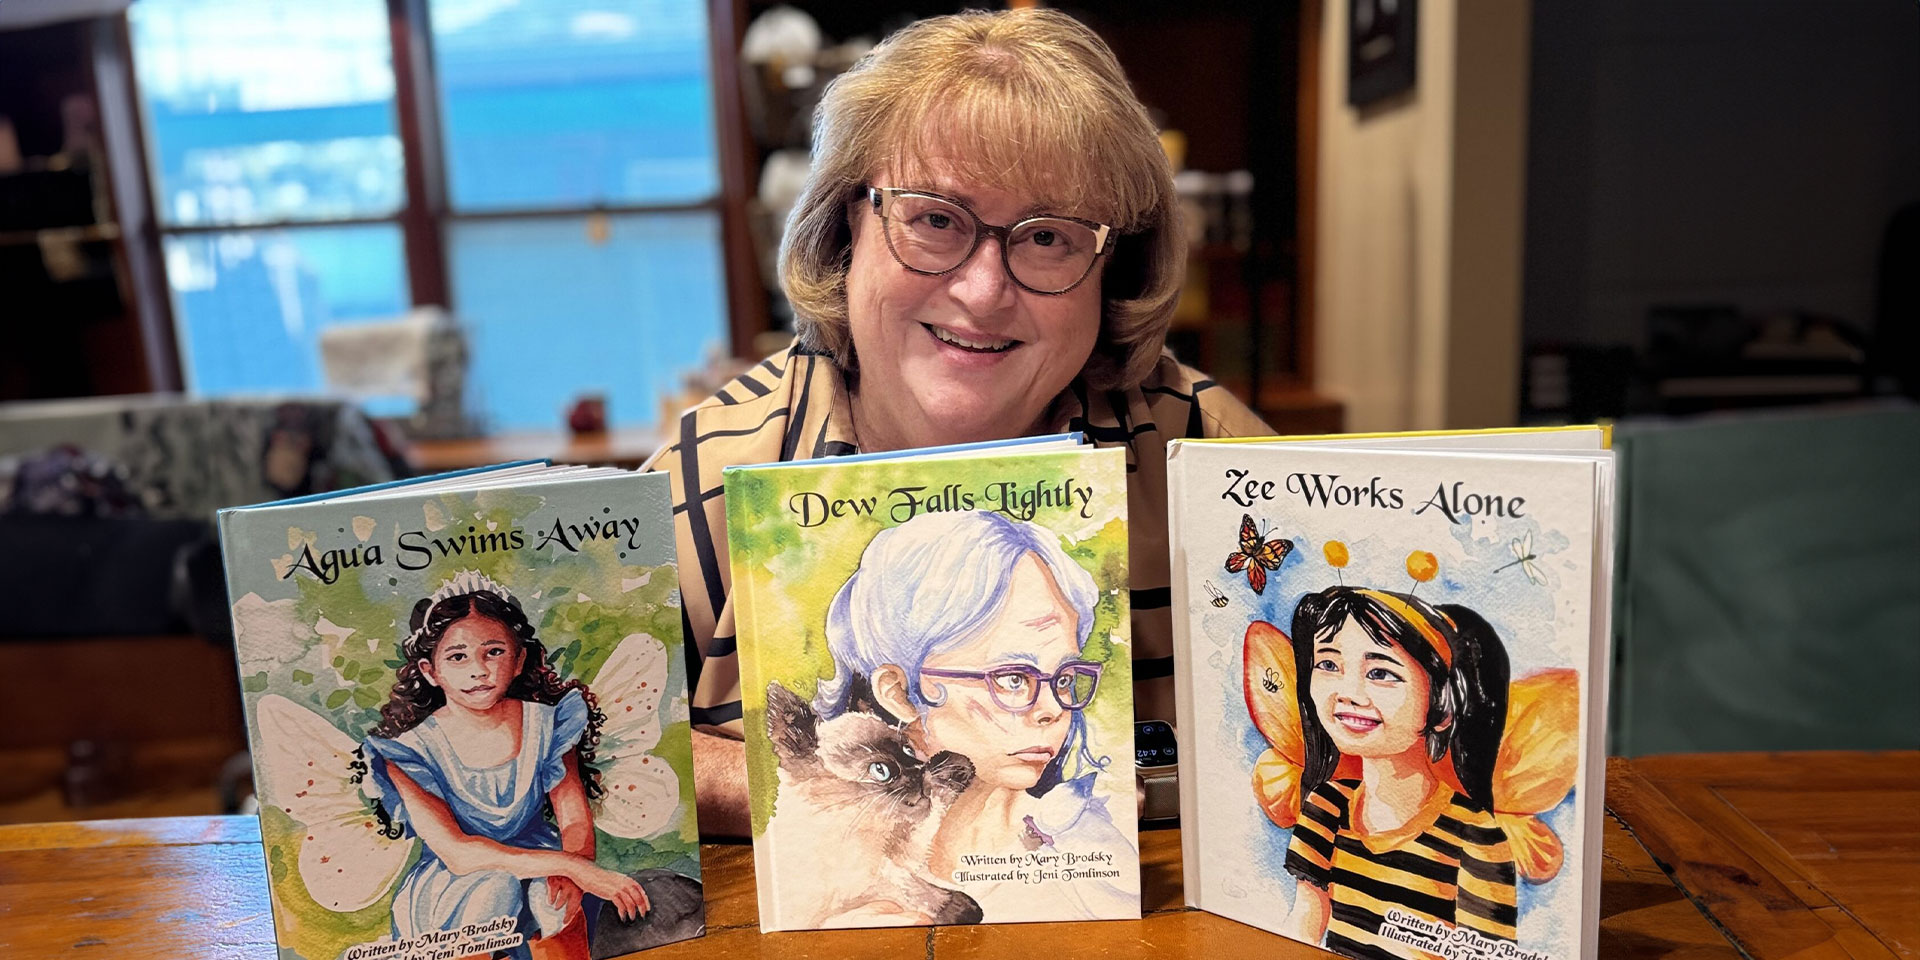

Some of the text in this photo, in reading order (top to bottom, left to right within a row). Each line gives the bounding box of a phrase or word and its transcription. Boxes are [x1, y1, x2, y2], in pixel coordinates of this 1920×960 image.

[789, 478, 1094, 528] Dew Falls Lightly
[1222, 468, 1526, 525] Zee Works Alone
[283, 514, 641, 585] Agua Swims Away
[955, 868, 1120, 884] Illustrated by Jeni Tomlinson
[961, 851, 1113, 868] Written by Mary Brodsky
[347, 917, 515, 960] Written by Mary Brodsky
[427, 948, 455, 960] Jeni
[457, 935, 520, 955] Tomlinson
[1381, 925, 1442, 954] Illustrated
[1444, 945, 1460, 960] by
[1387, 908, 1434, 935] Written
[1435, 923, 1451, 940] by
[1451, 930, 1498, 954] Mary
